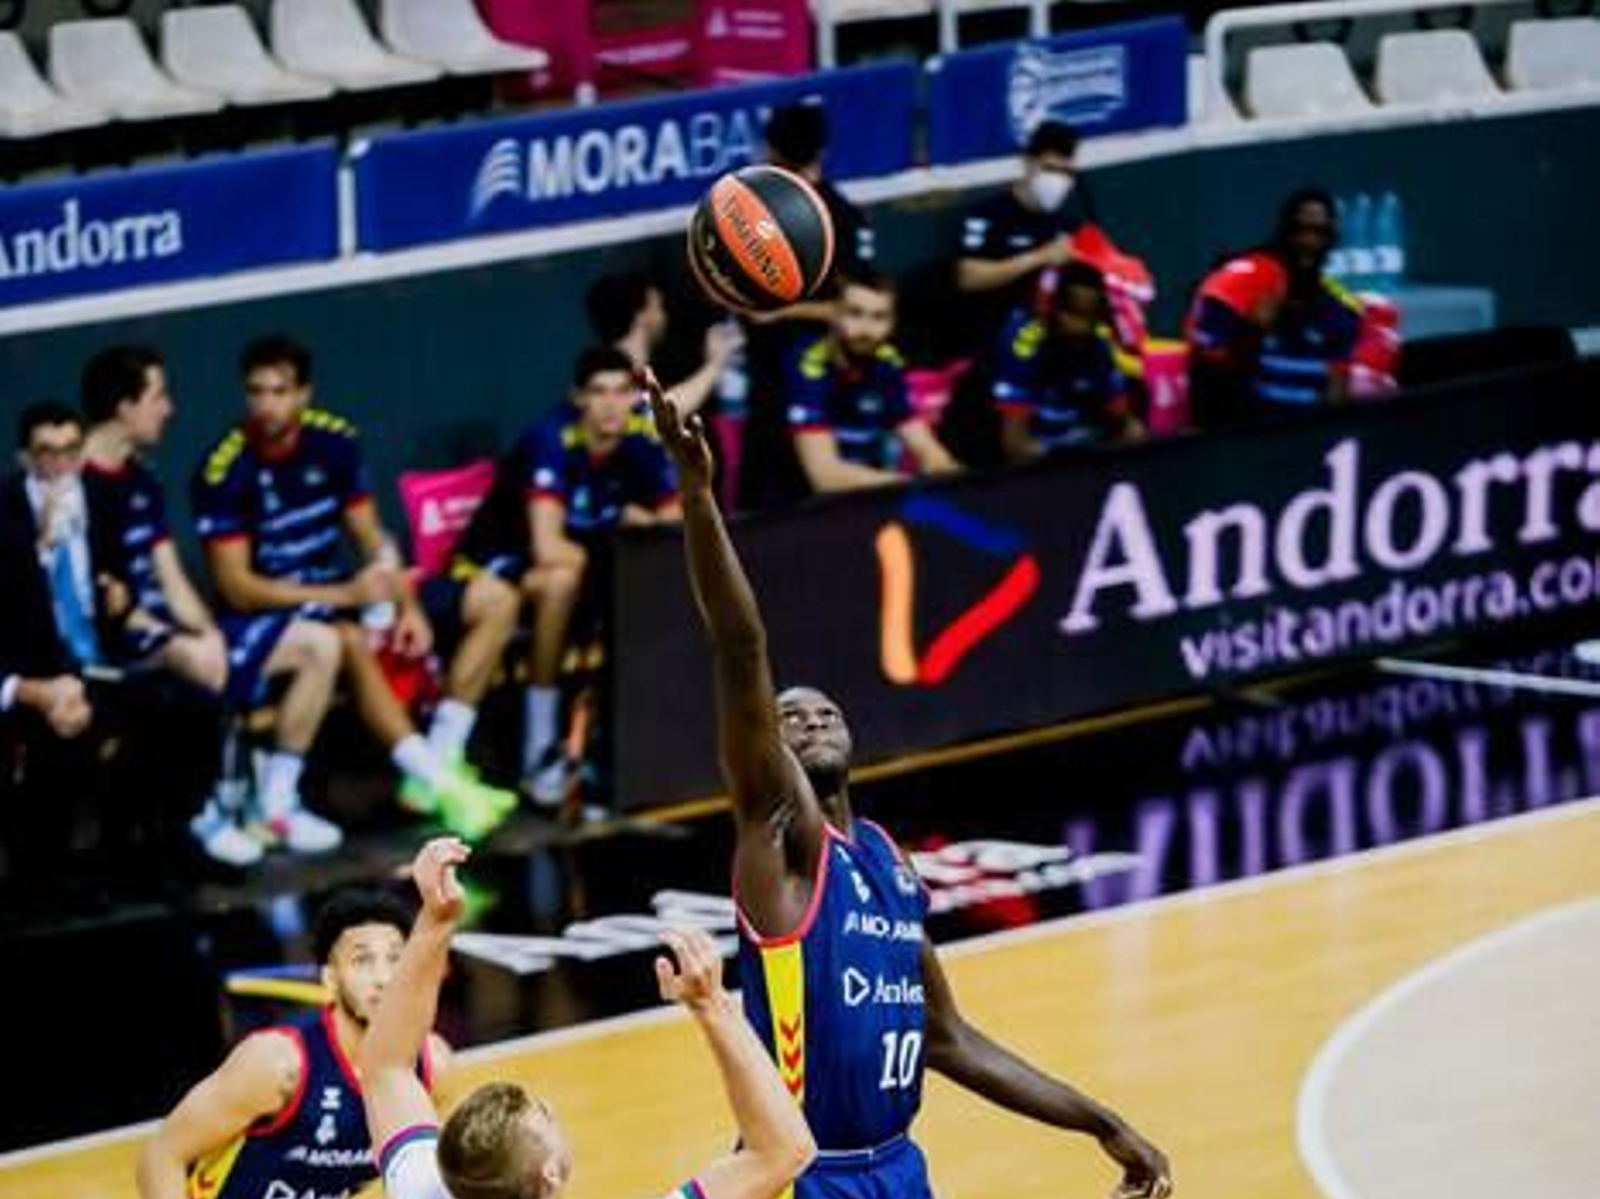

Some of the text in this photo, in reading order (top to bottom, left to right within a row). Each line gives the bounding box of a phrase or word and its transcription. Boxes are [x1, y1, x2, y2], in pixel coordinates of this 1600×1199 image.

[526, 105, 773, 201] MORABA
[1180, 556, 1600, 678] visitandorra.co
[879, 1030, 923, 1090] 10
